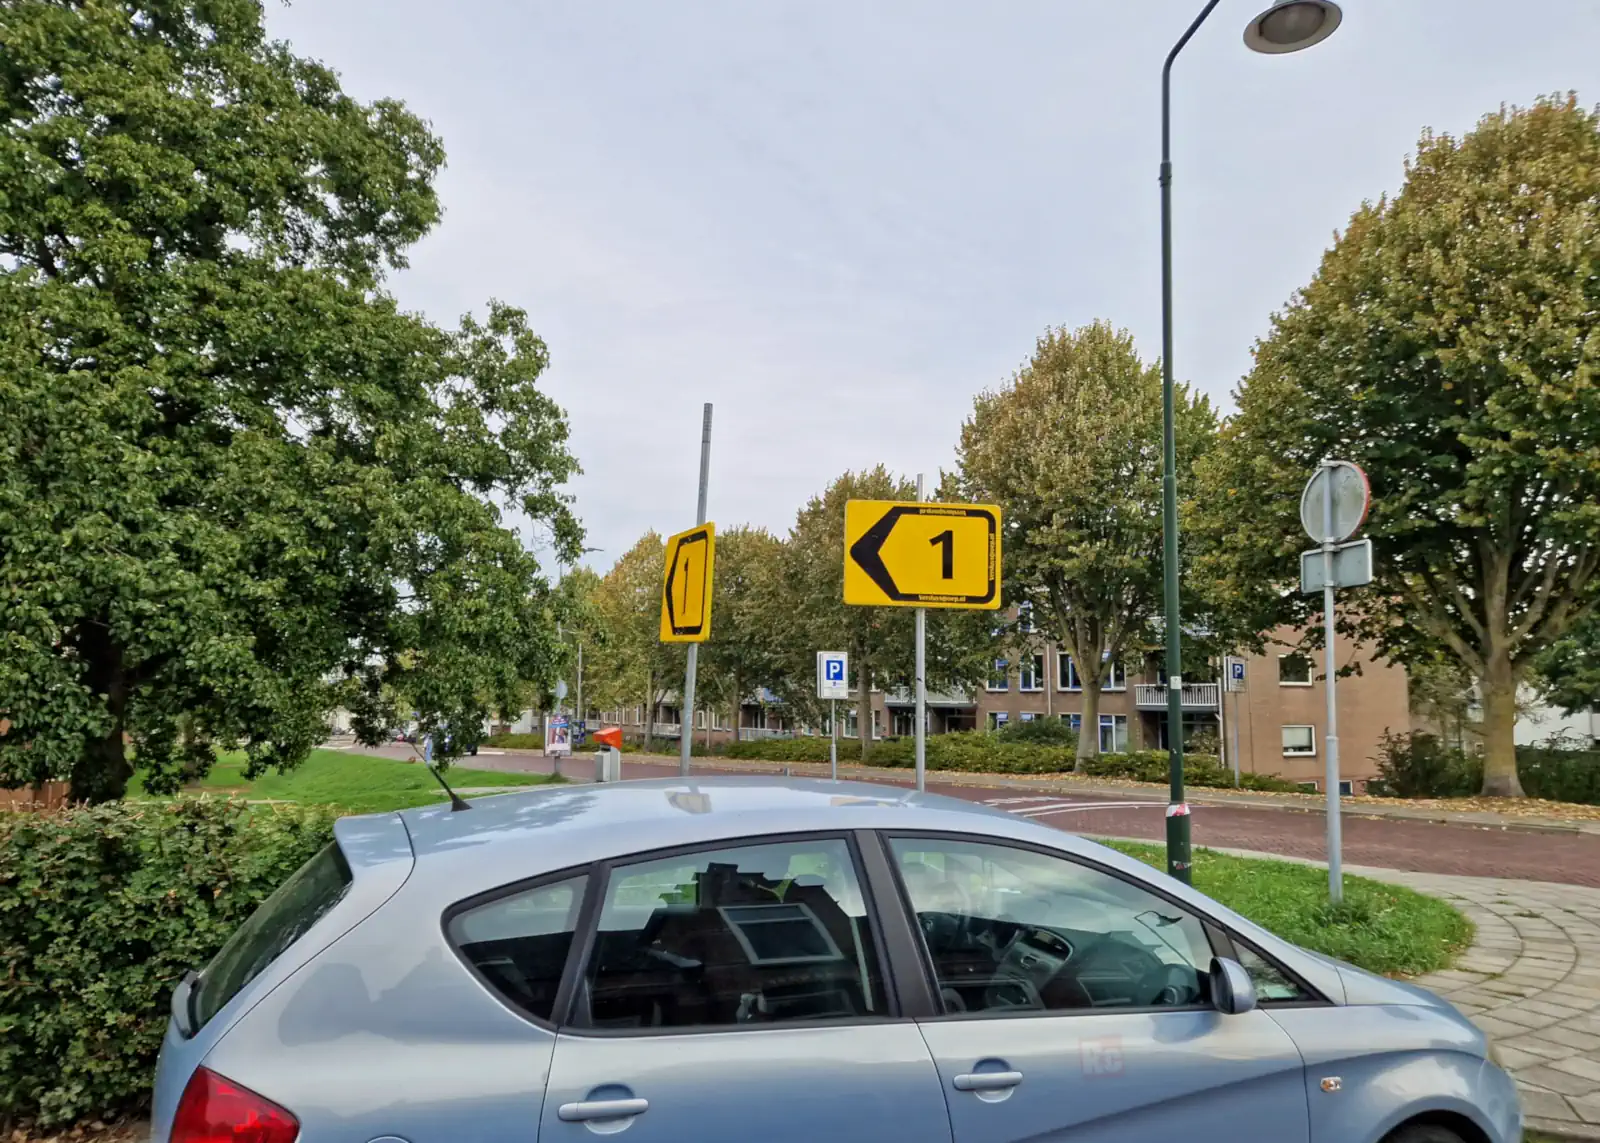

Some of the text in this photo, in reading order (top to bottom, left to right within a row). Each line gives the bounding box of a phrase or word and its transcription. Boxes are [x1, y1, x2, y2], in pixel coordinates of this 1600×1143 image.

[929, 530, 953, 579] 1
[682, 556, 689, 616] 1
[830, 661, 841, 680] P
